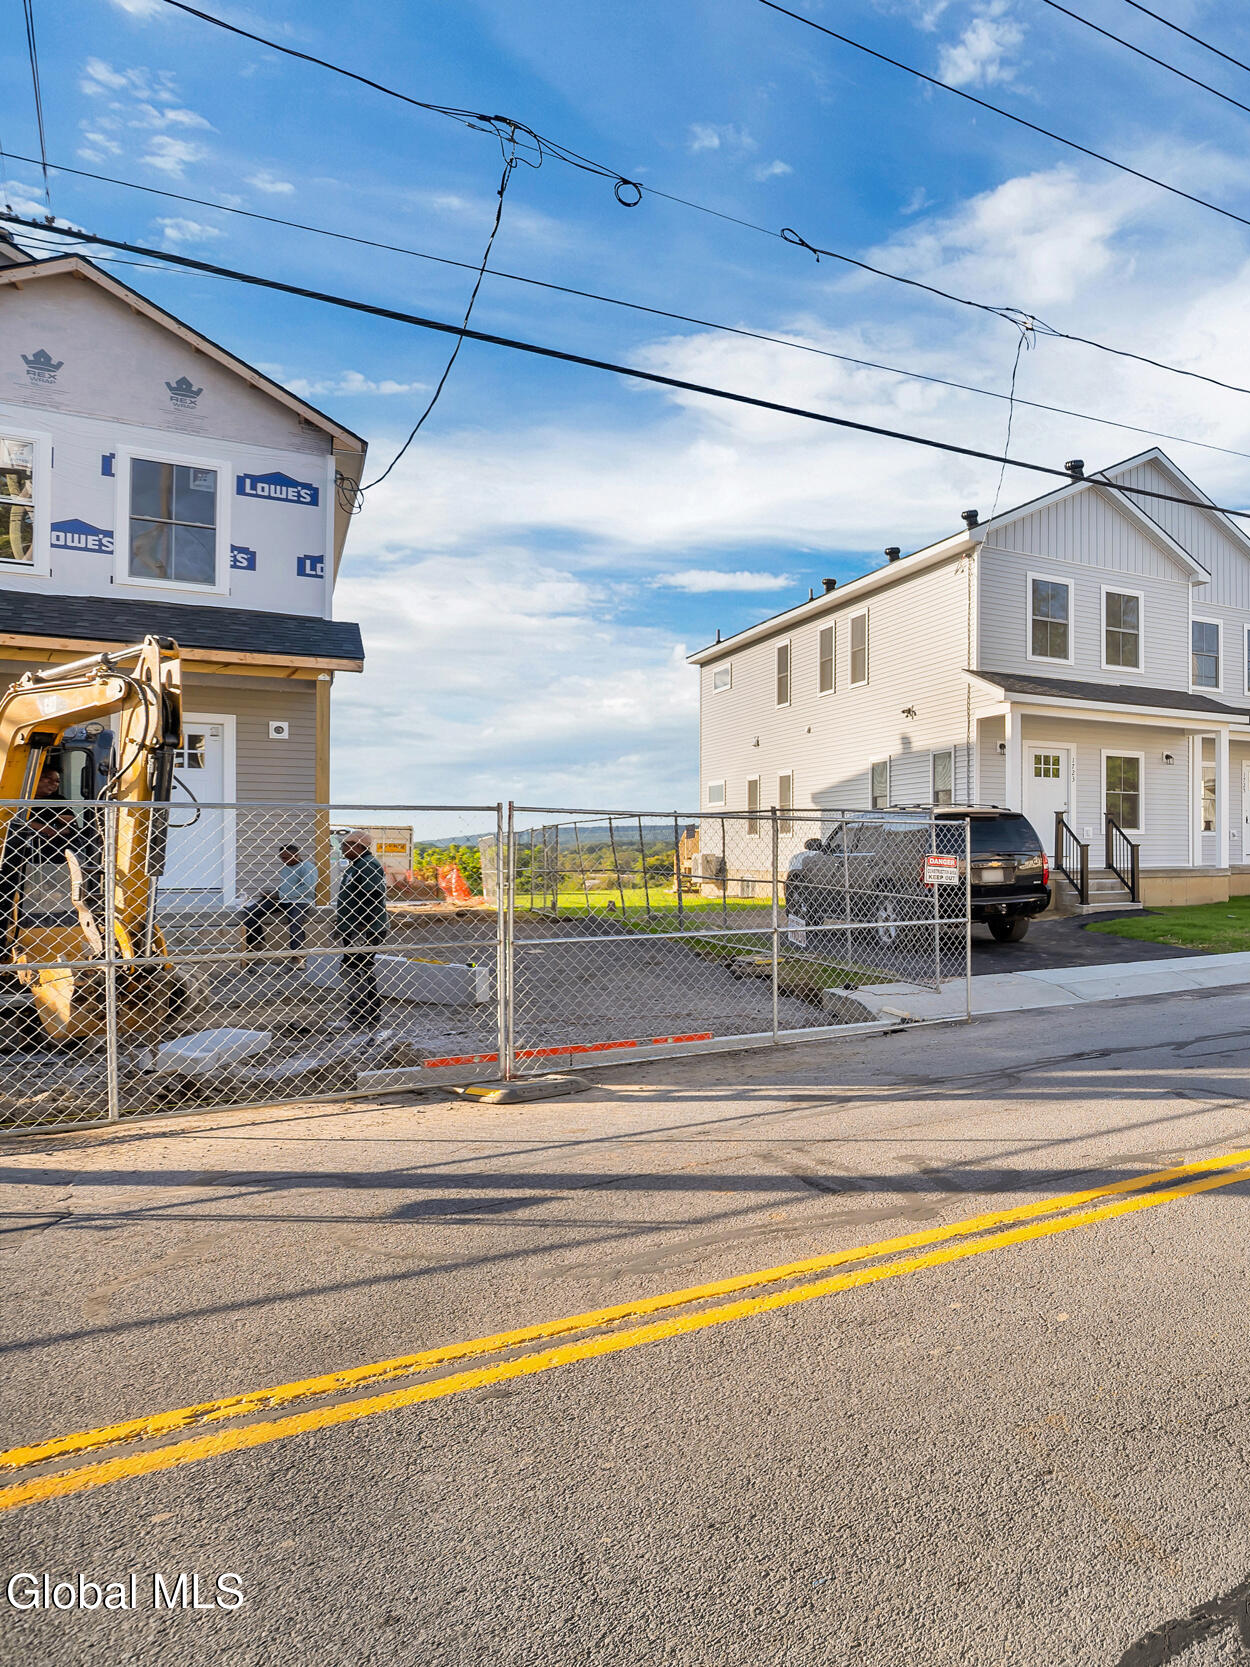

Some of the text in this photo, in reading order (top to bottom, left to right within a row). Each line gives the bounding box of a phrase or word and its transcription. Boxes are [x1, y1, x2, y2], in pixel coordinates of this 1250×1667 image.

[26, 369, 57, 380] REX
[170, 395, 198, 406] REX
[245, 478, 312, 503] LOWE'S
[51, 531, 114, 551] OWE'S
[929, 857, 955, 866] DANGER
